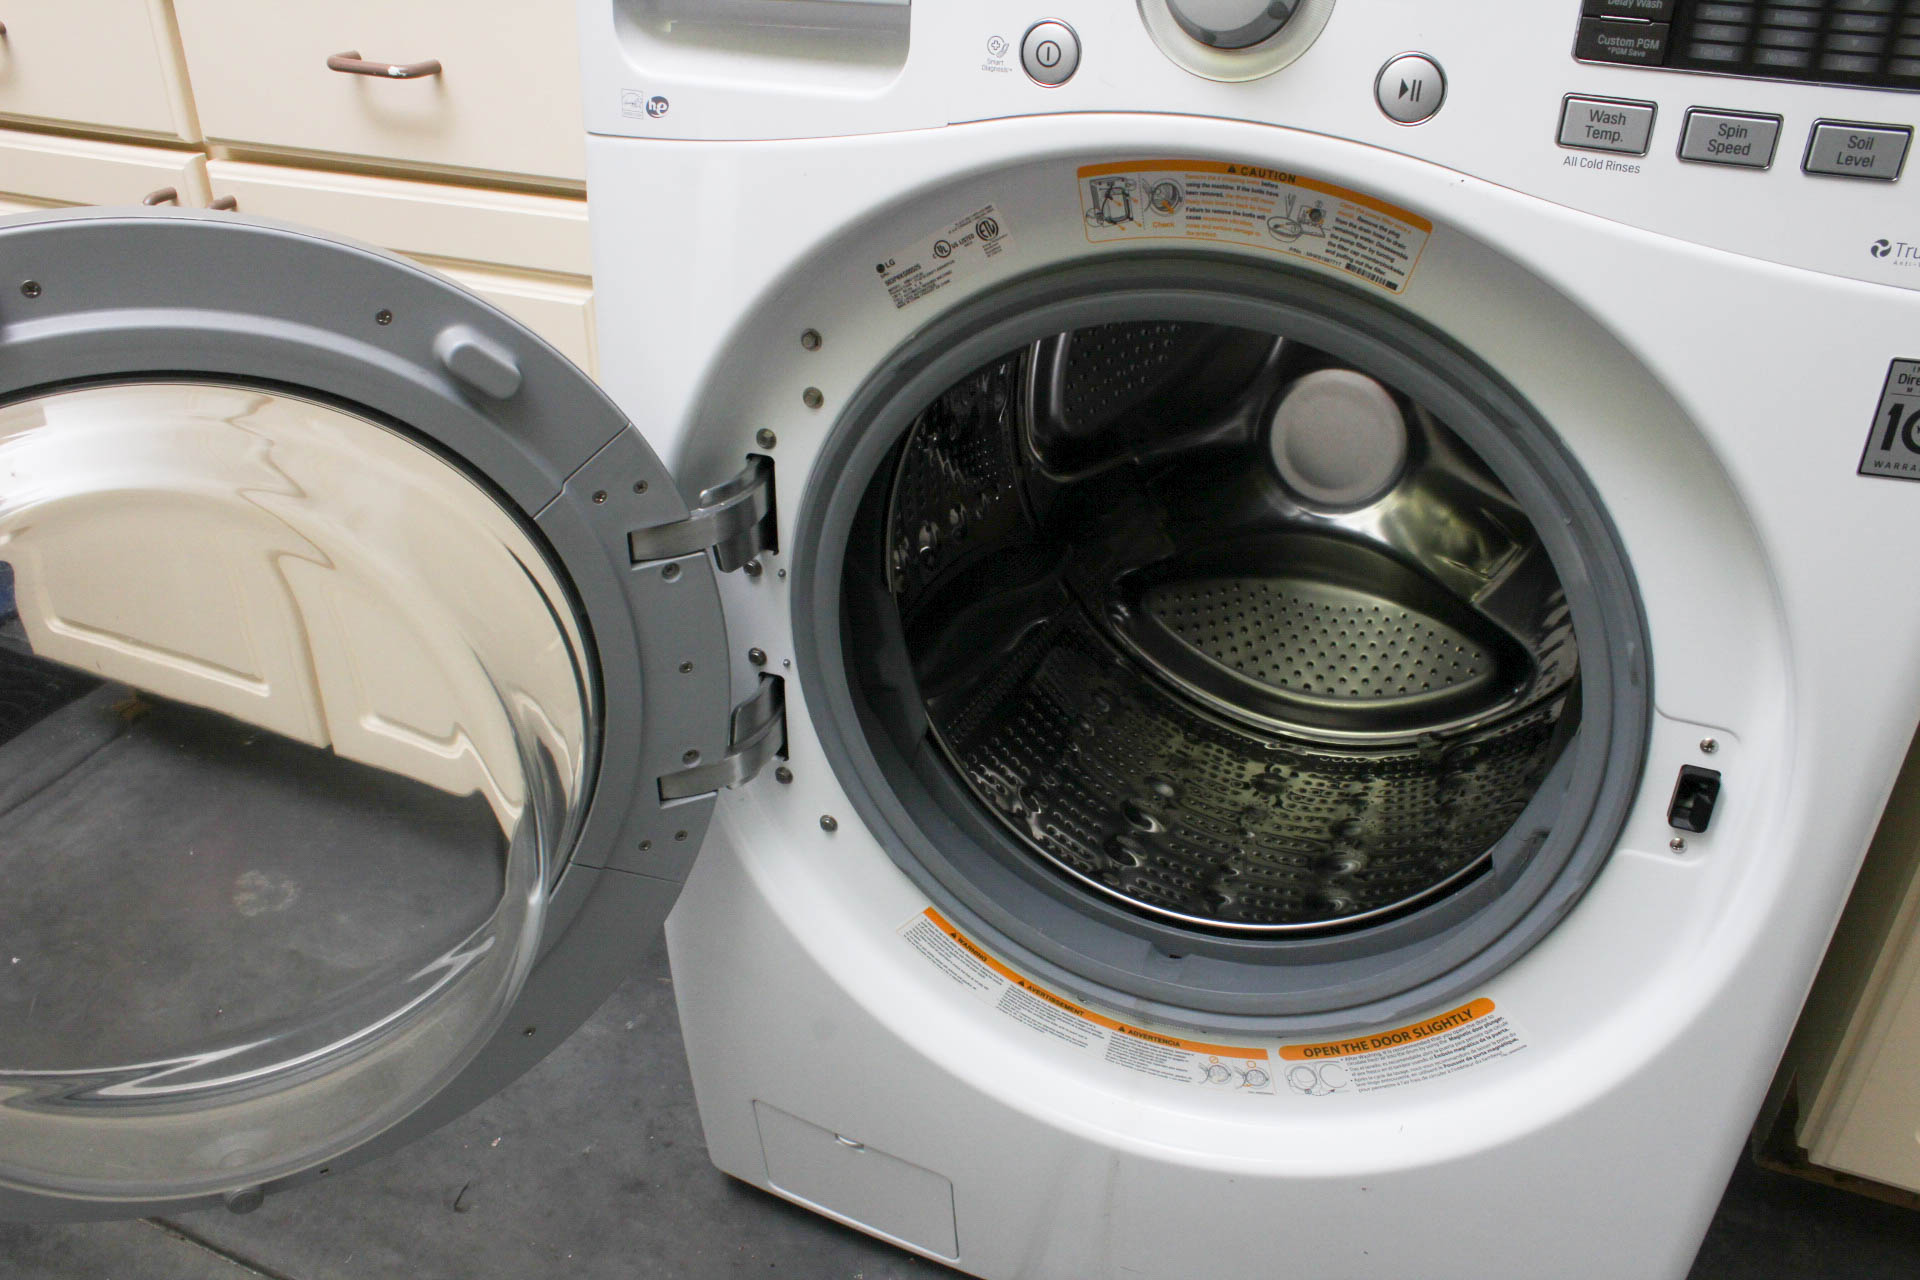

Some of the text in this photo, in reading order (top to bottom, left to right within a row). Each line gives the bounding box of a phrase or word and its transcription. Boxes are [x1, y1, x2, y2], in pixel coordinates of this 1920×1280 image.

[1598, 34, 1660, 50] Custom PGM
[1628, 48, 1646, 57] Save
[1589, 109, 1627, 126] Wash
[1584, 126, 1624, 144] Temp.
[1717, 123, 1749, 139] Spin
[1706, 139, 1752, 157] Speed
[1847, 135, 1875, 151] Soil
[1563, 156, 1641, 175] All Cold Rinses
[1836, 152, 1875, 168] Level
[1241, 166, 1297, 183] CAUTION
[884, 258, 896, 268] LG
[958, 937, 988, 962] WARNING
[1027, 985, 1085, 1017] AVERTISSEMENT
[1127, 1028, 1181, 1048] ADVERTENCIA
[1303, 1008, 1474, 1058] OPEN THE DOOR SLIGHTLY
